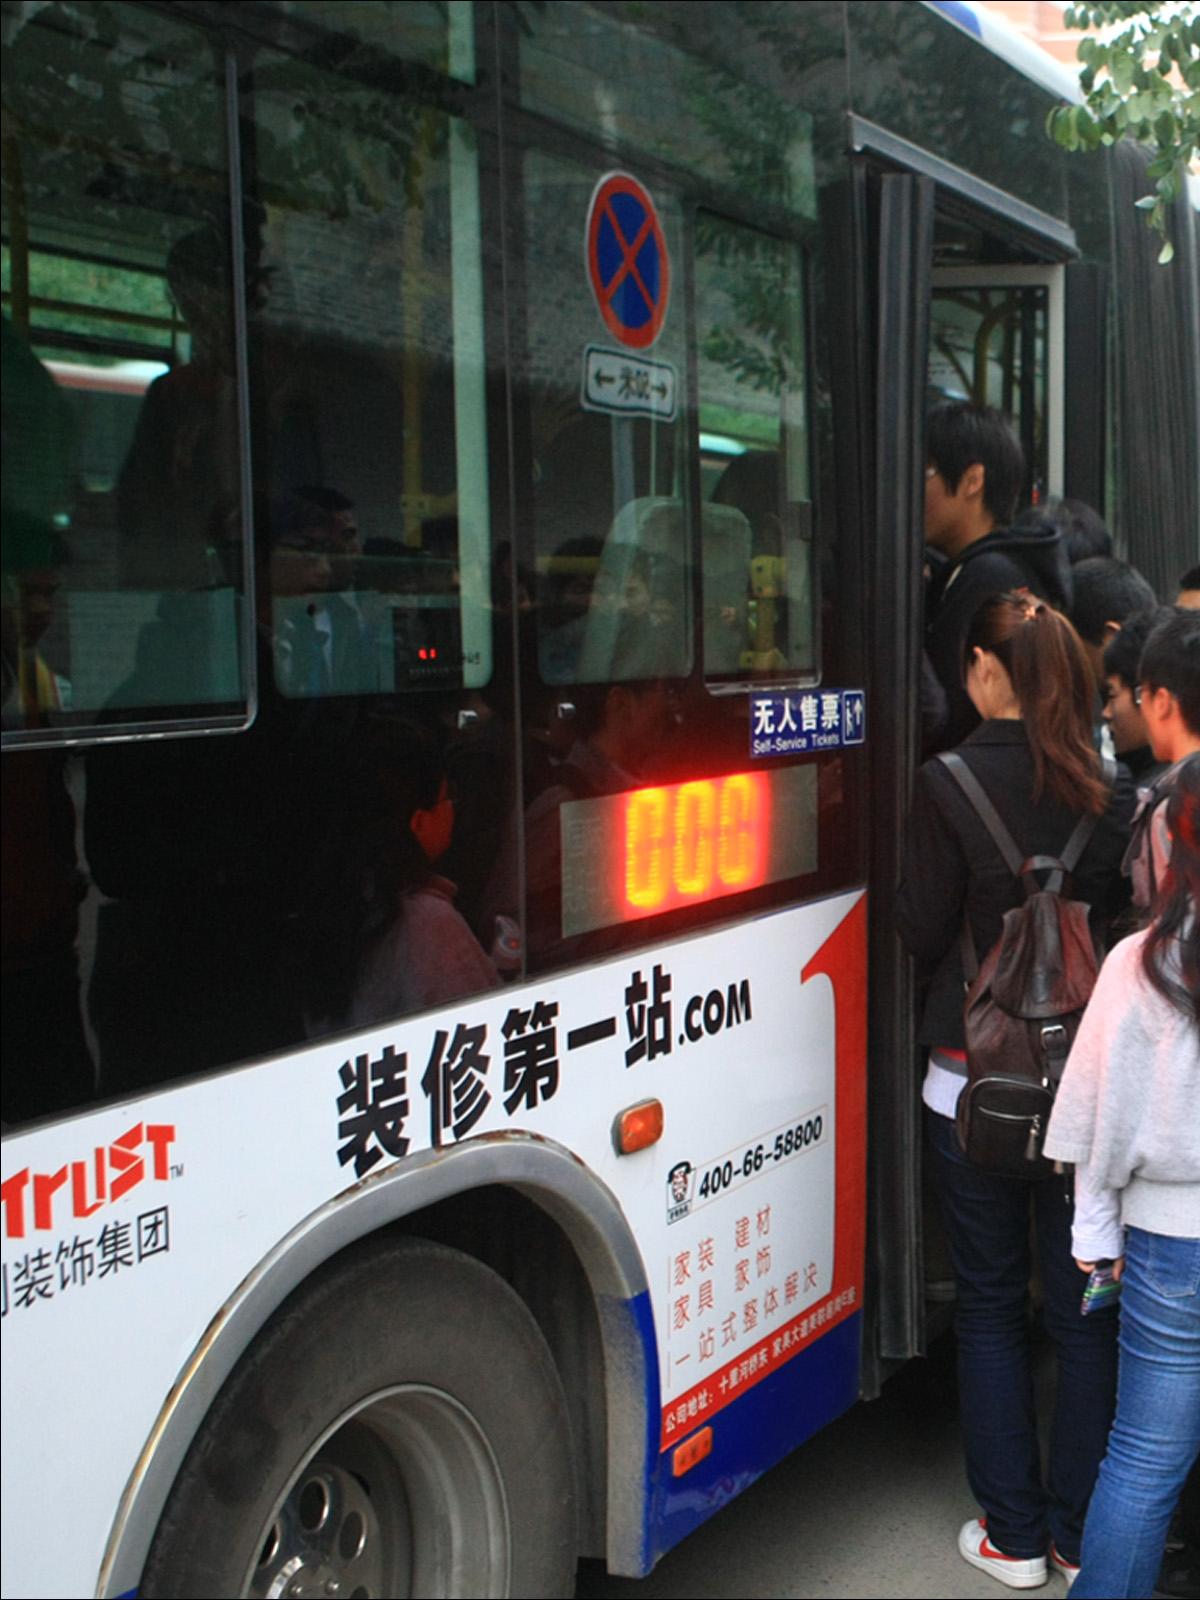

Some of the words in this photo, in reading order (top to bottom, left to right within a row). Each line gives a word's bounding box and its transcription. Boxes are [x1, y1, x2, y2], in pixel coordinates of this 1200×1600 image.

[754, 693, 839, 735] 无人售票
[753, 737, 807, 754] Self-Service
[699, 1115, 823, 1199] 400-66-58800
[1, 1205, 170, 1318] 装饰集团
[674, 1236, 714, 1286] 家装
[674, 1279, 714, 1330] 家具
